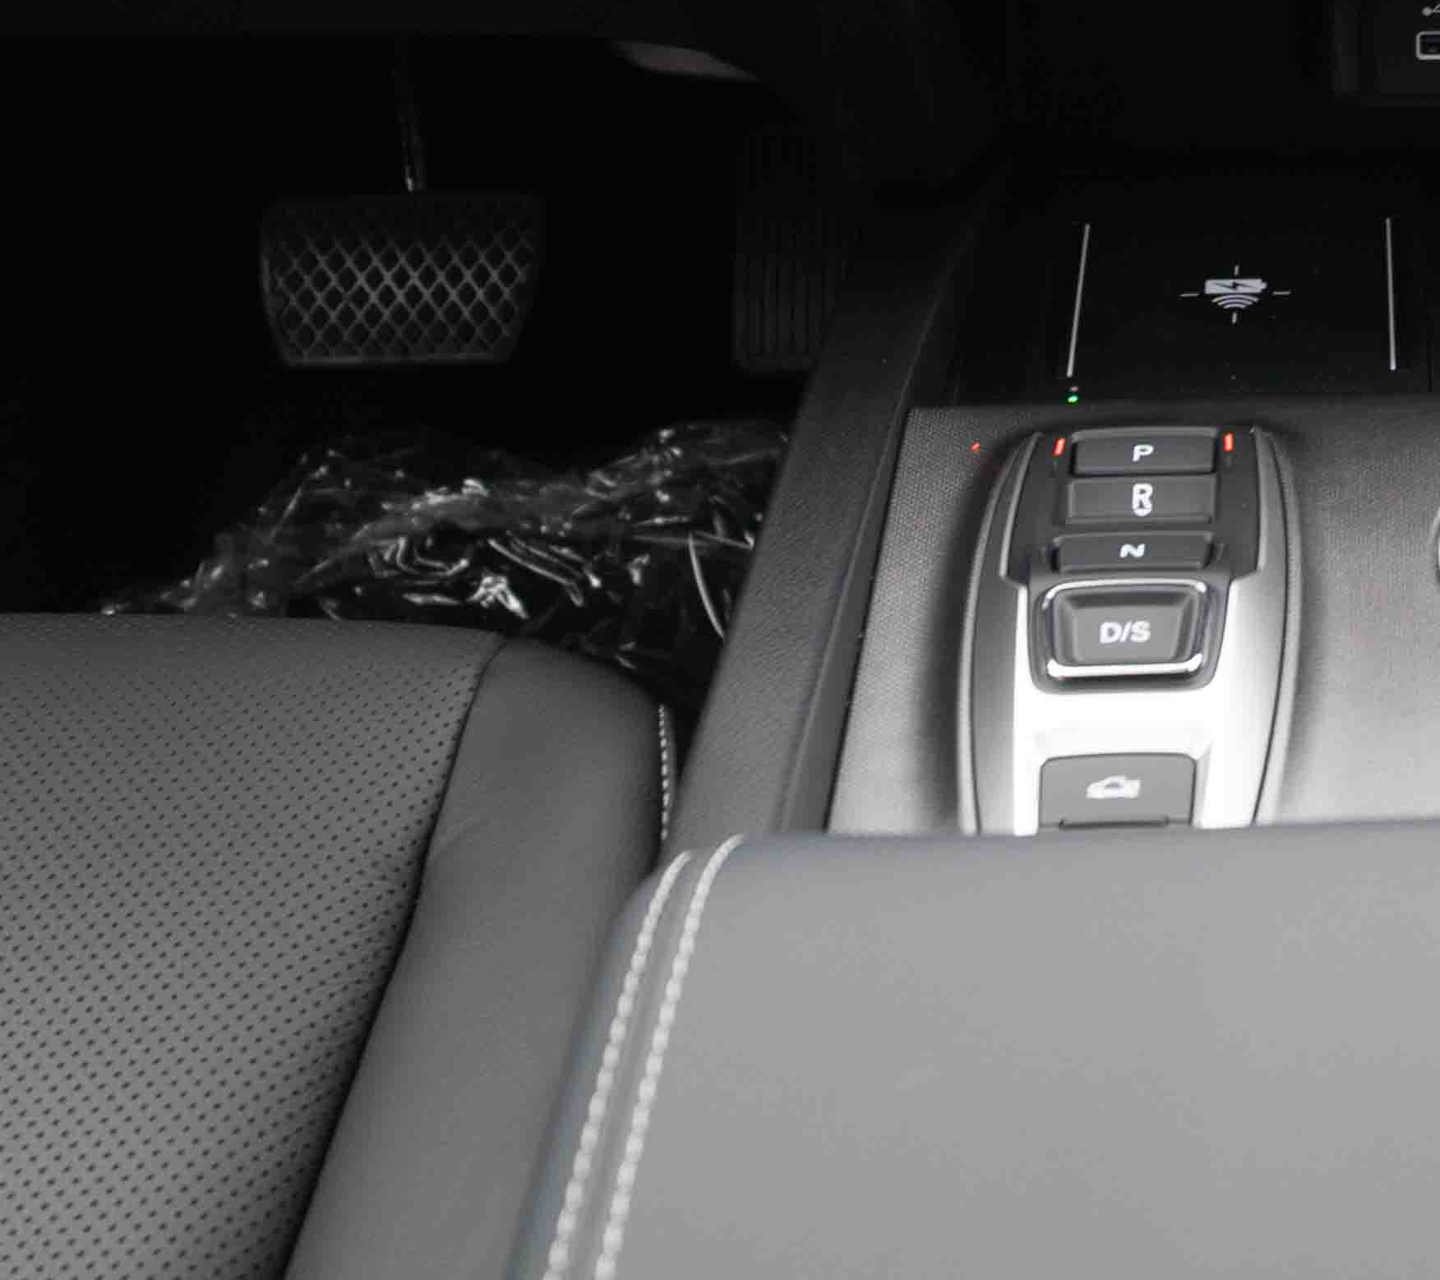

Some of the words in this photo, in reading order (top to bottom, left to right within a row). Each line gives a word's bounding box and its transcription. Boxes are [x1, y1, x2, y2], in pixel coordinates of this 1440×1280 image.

[1132, 444, 1153, 462] P
[1131, 483, 1152, 507] R
[1120, 543, 1145, 558] N
[1098, 620, 1151, 644] D/S
